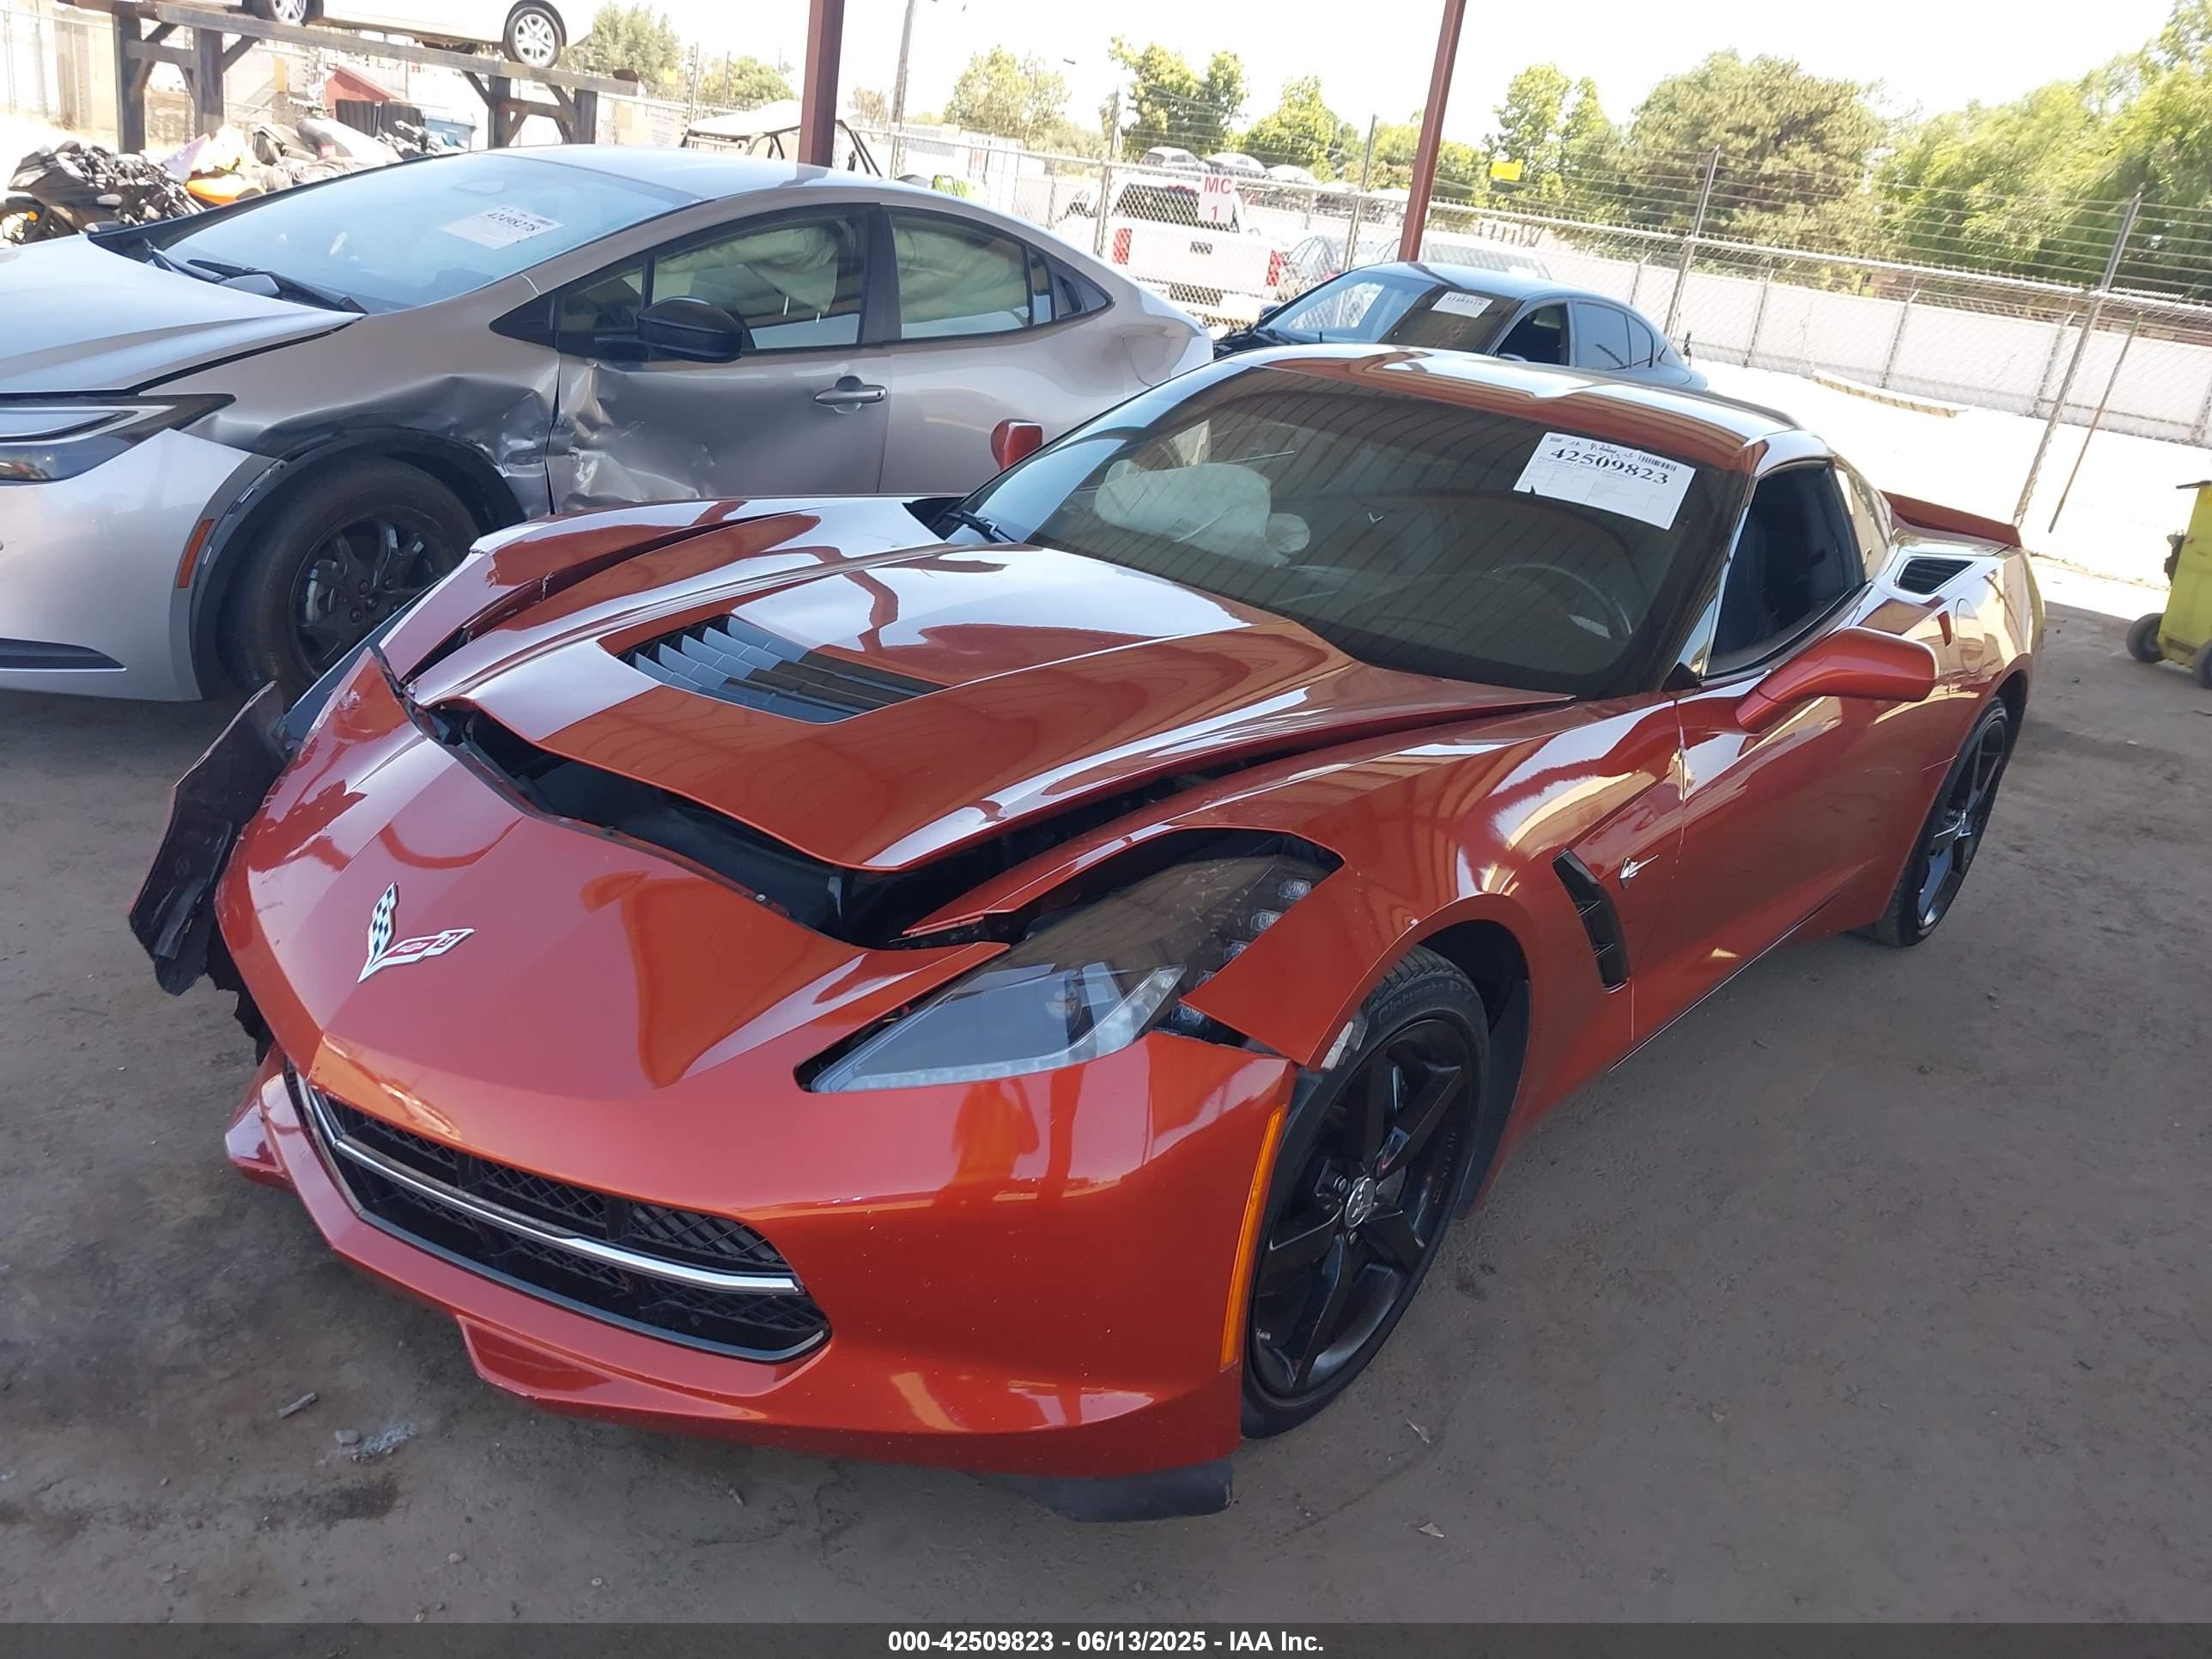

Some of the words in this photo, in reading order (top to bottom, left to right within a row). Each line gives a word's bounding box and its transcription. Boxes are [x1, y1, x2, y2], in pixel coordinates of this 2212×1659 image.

[1204, 176, 1231, 195] MC
[1212, 205, 1218, 221] 1
[1550, 447, 1668, 485] 42509823
